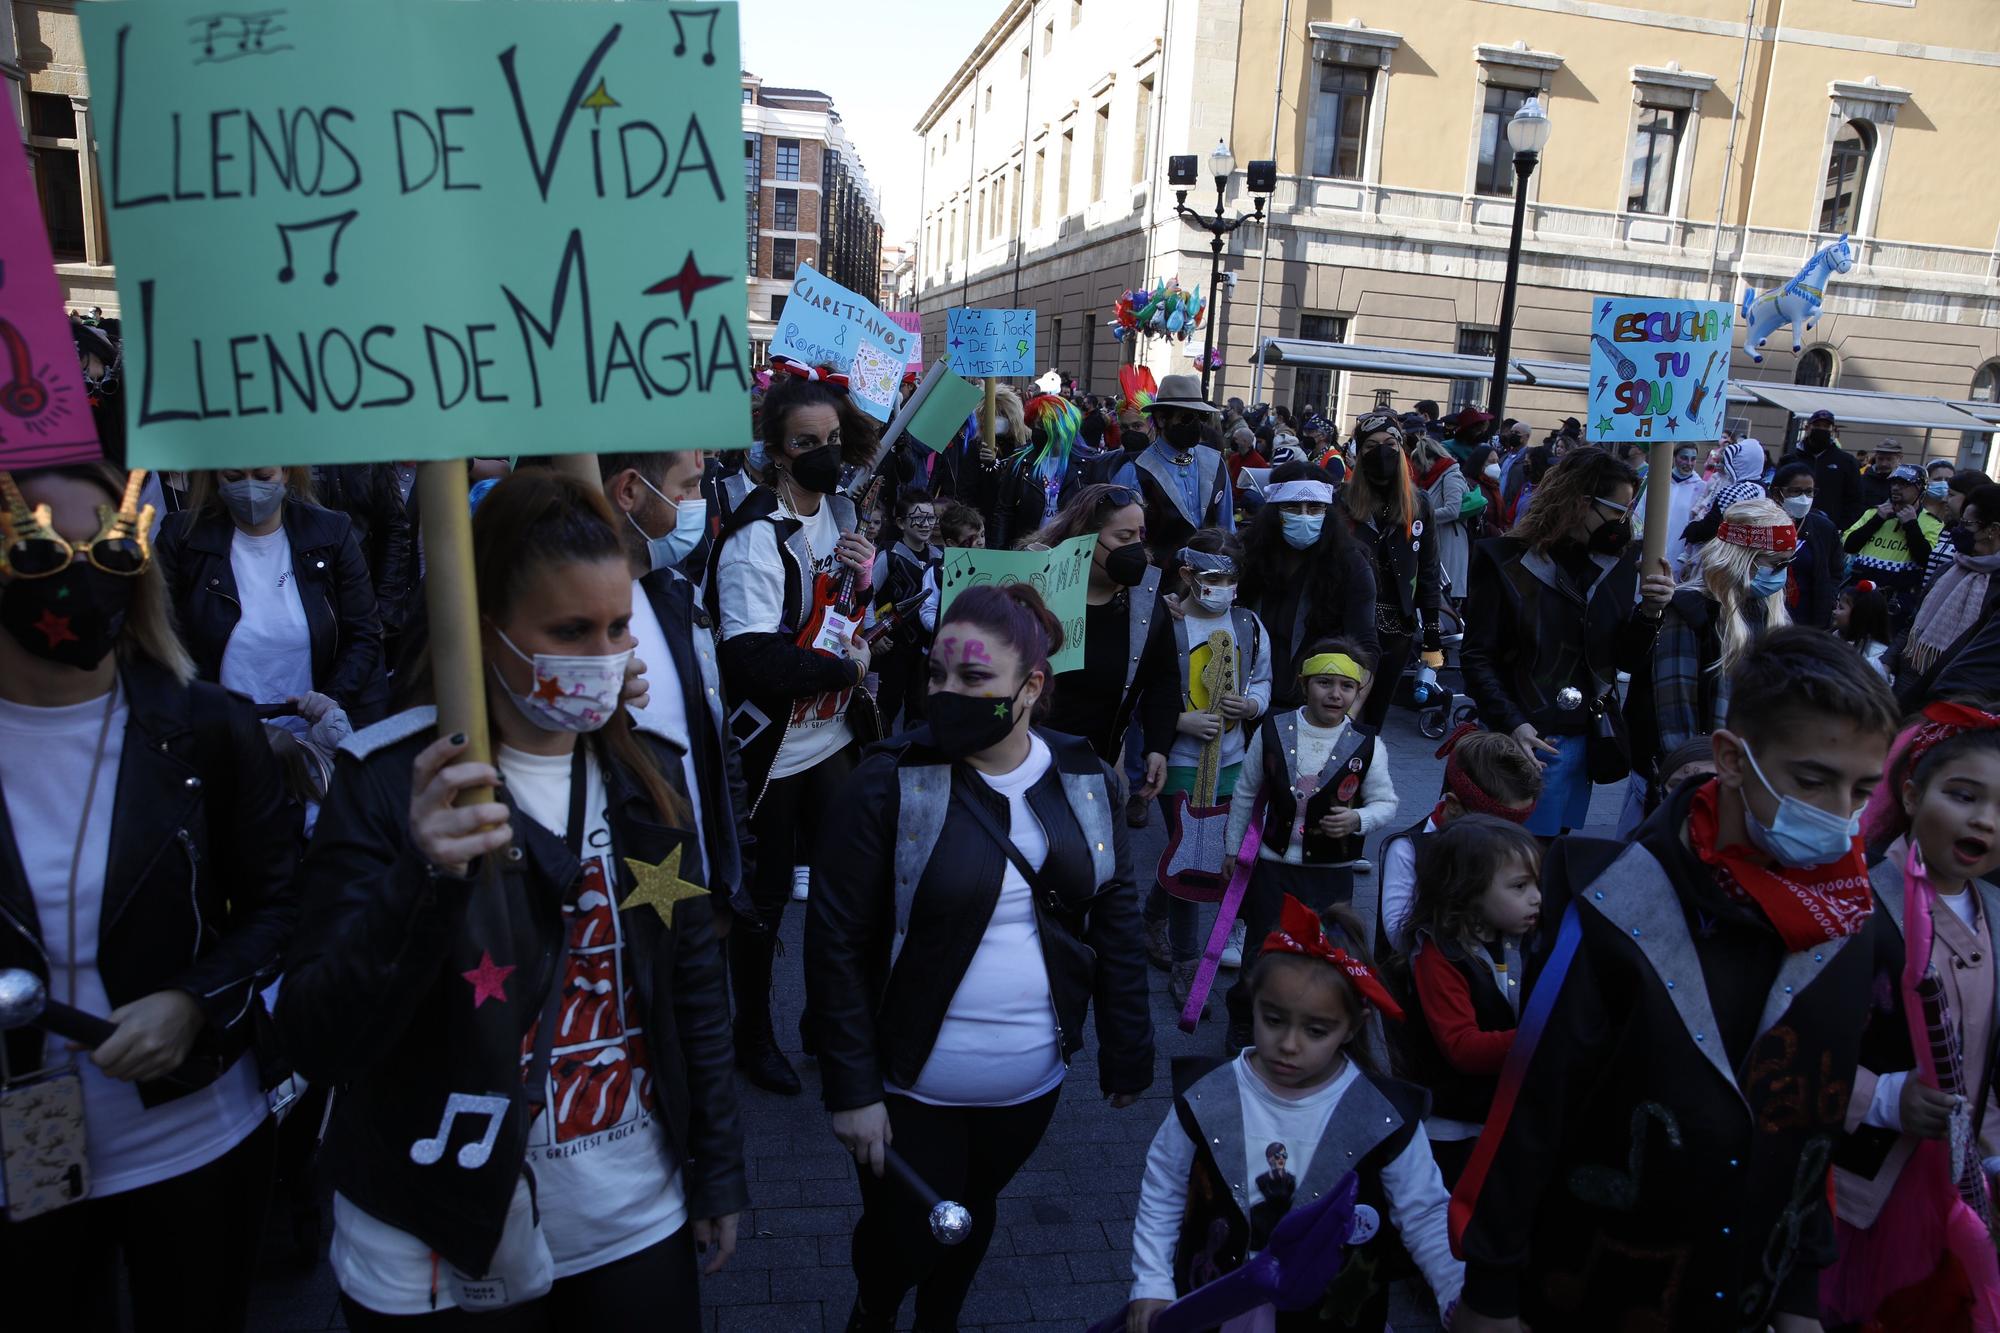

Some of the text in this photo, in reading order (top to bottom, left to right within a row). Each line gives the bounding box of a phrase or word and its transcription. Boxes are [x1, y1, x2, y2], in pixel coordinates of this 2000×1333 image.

[112, 24, 363, 210] LLENOS
[393, 107, 482, 195] DE
[793, 277, 907, 354] CLARETIANOS
[948, 310, 1033, 338] VIVA EL ROCK
[1613, 309, 1718, 343] ESCUCHA
[138, 280, 415, 428] LLENOS
[424, 324, 510, 411] DE
[968, 338, 1008, 352] DE LA
[951, 355, 1024, 374] AMISTAD
[1655, 351, 1690, 378] TU
[1613, 379, 1673, 416] SON
[546, 1135, 601, 1160] GREATEST
[608, 1124, 635, 1142] ROCK
